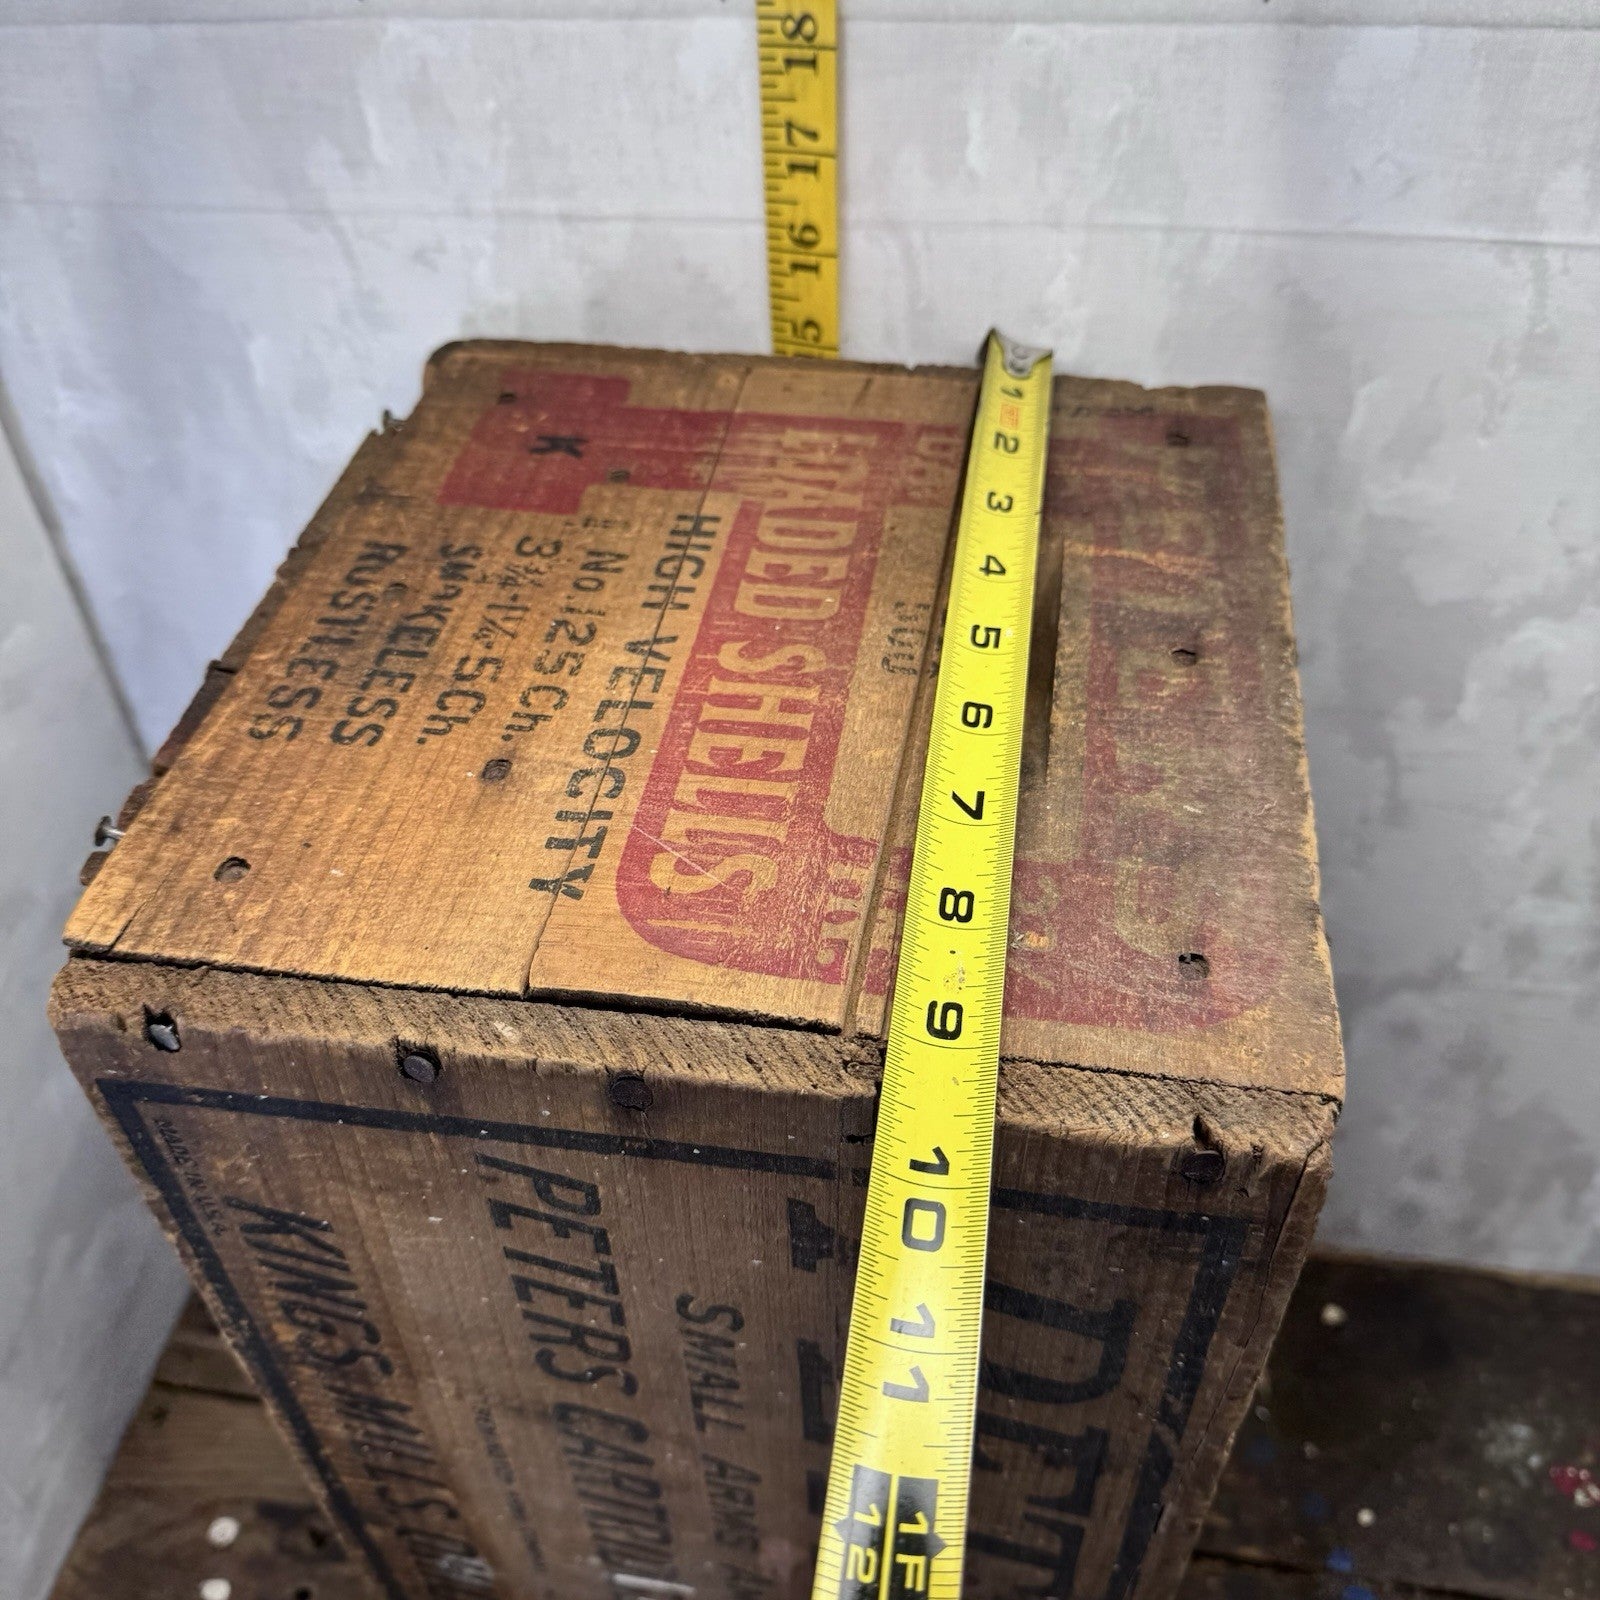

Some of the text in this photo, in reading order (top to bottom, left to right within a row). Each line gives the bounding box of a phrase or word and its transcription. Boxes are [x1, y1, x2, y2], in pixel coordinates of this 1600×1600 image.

[780, 12, 821, 76] 18
[783, 117, 821, 178] 17
[785, 220, 822, 276] 16
[993, 430, 1020, 456] 2
[985, 490, 1015, 514] 3
[641, 512, 722, 612] HIGH
[978, 553, 1007, 578] 4
[969, 623, 1002, 651] 5
[960, 700, 994, 730] 6
[528, 633, 673, 902] VELOCITY
[649, 640, 827, 894] SHELLS
[951, 789, 986, 821] 7
[938, 886, 975, 924] 8
[926, 999, 964, 1041] 9
[901, 1146, 951, 1253] 10
[223, 1196, 395, 1377] KINGS
[474, 1152, 640, 1397] PETERS
[675, 1292, 747, 1433] SMALL
[881, 1301, 937, 1404] 11
[845, 1502, 883, 1585] 12
